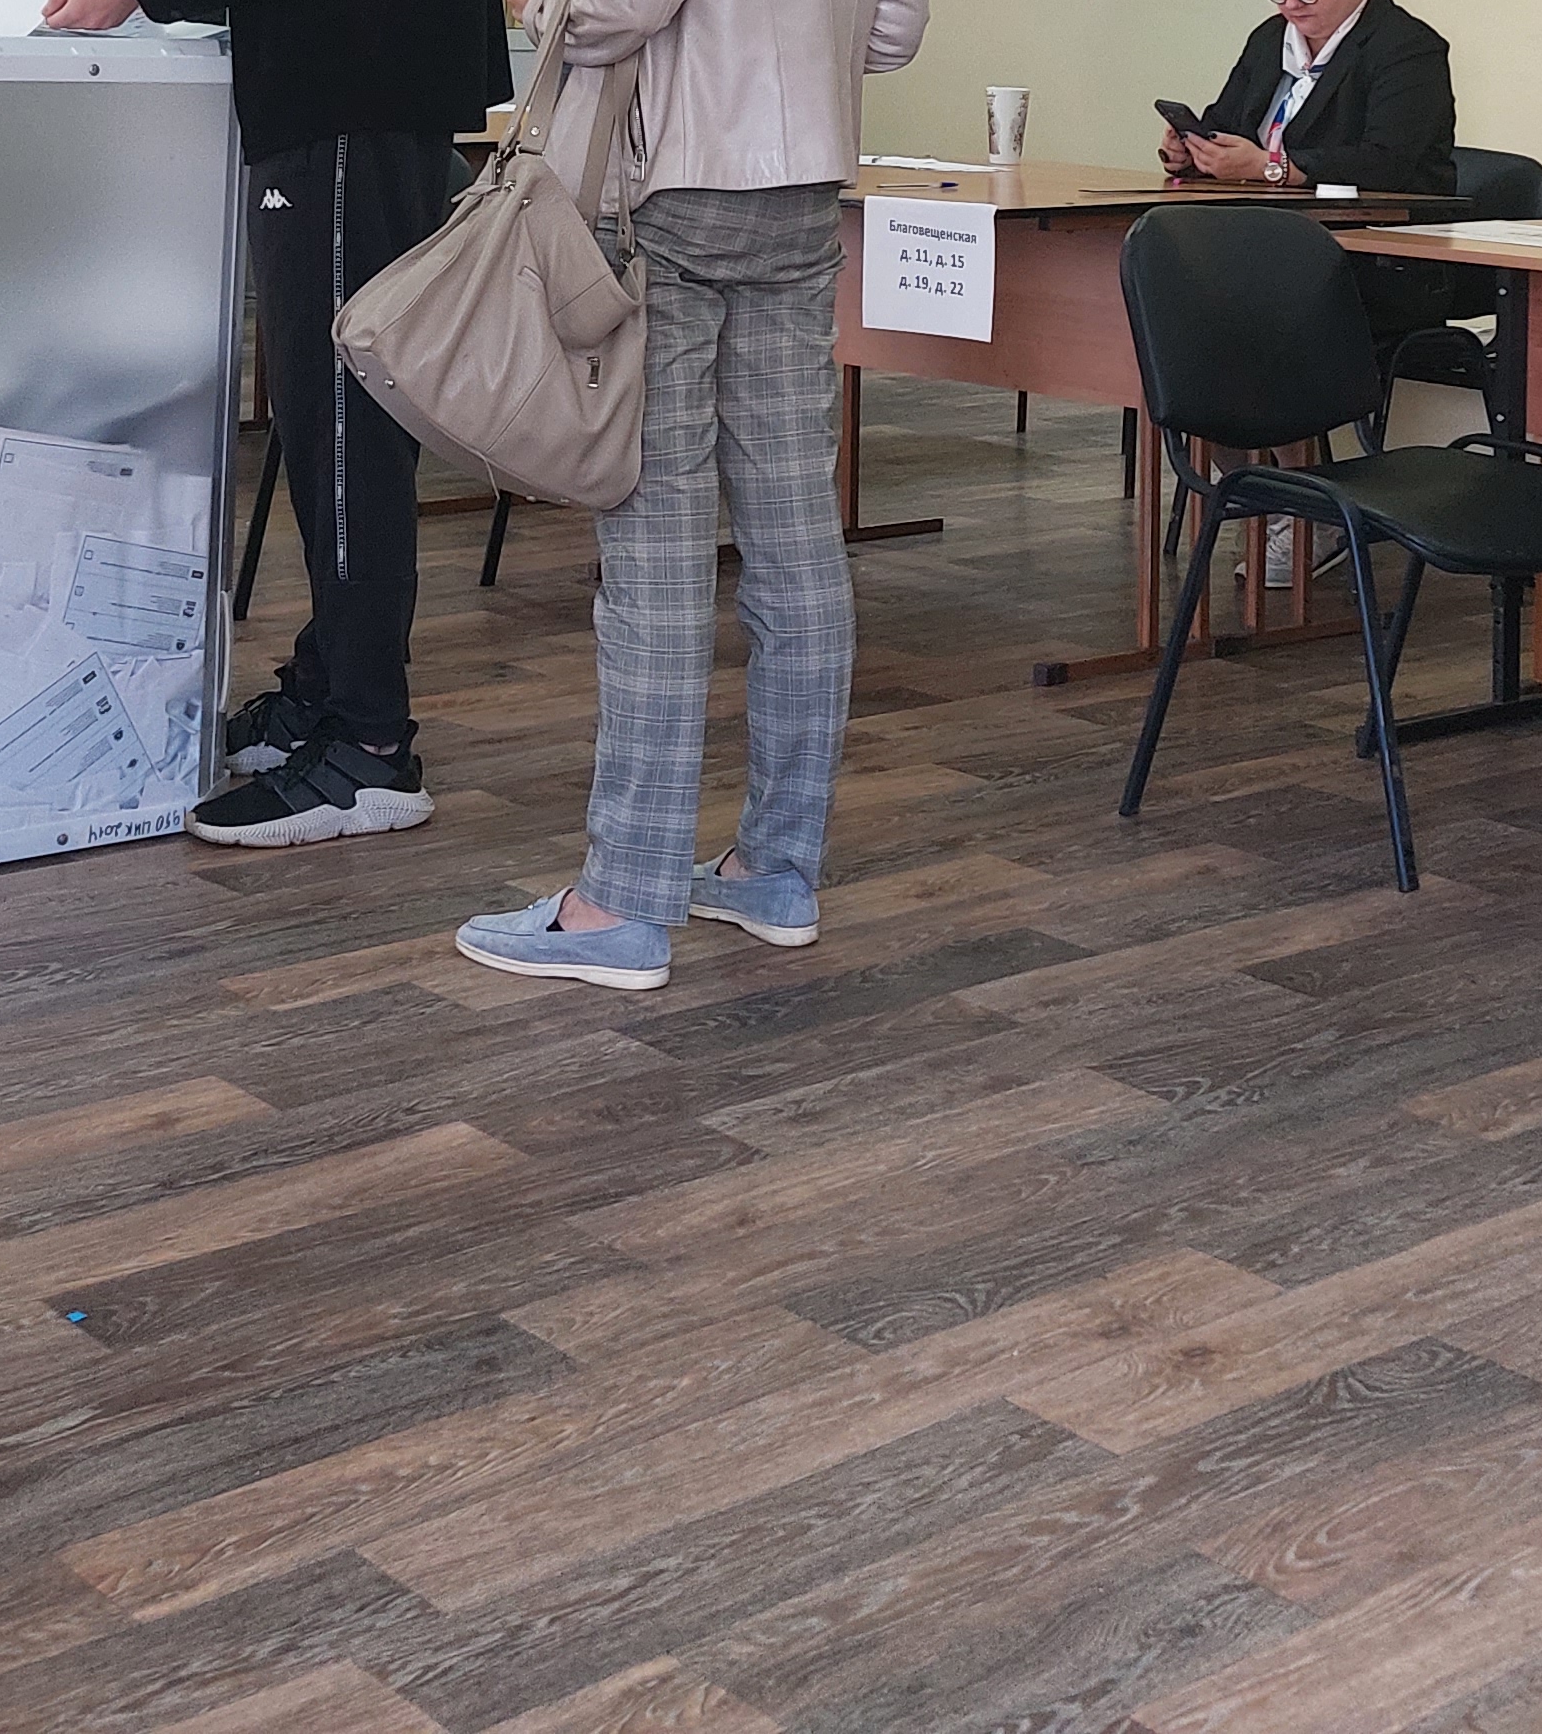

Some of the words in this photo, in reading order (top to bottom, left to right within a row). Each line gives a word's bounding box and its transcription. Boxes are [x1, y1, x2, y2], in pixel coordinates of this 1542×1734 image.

[889, 219, 977, 244] Благовещенская
[899, 249, 912, 262] д.
[915, 248, 933, 266] 11,
[935, 254, 948, 268] д.
[950, 254, 965, 269] 15
[898, 276, 912, 290] д.
[914, 275, 932, 293] 19,
[934, 282, 947, 296] д.
[950, 281, 964, 297] 22
